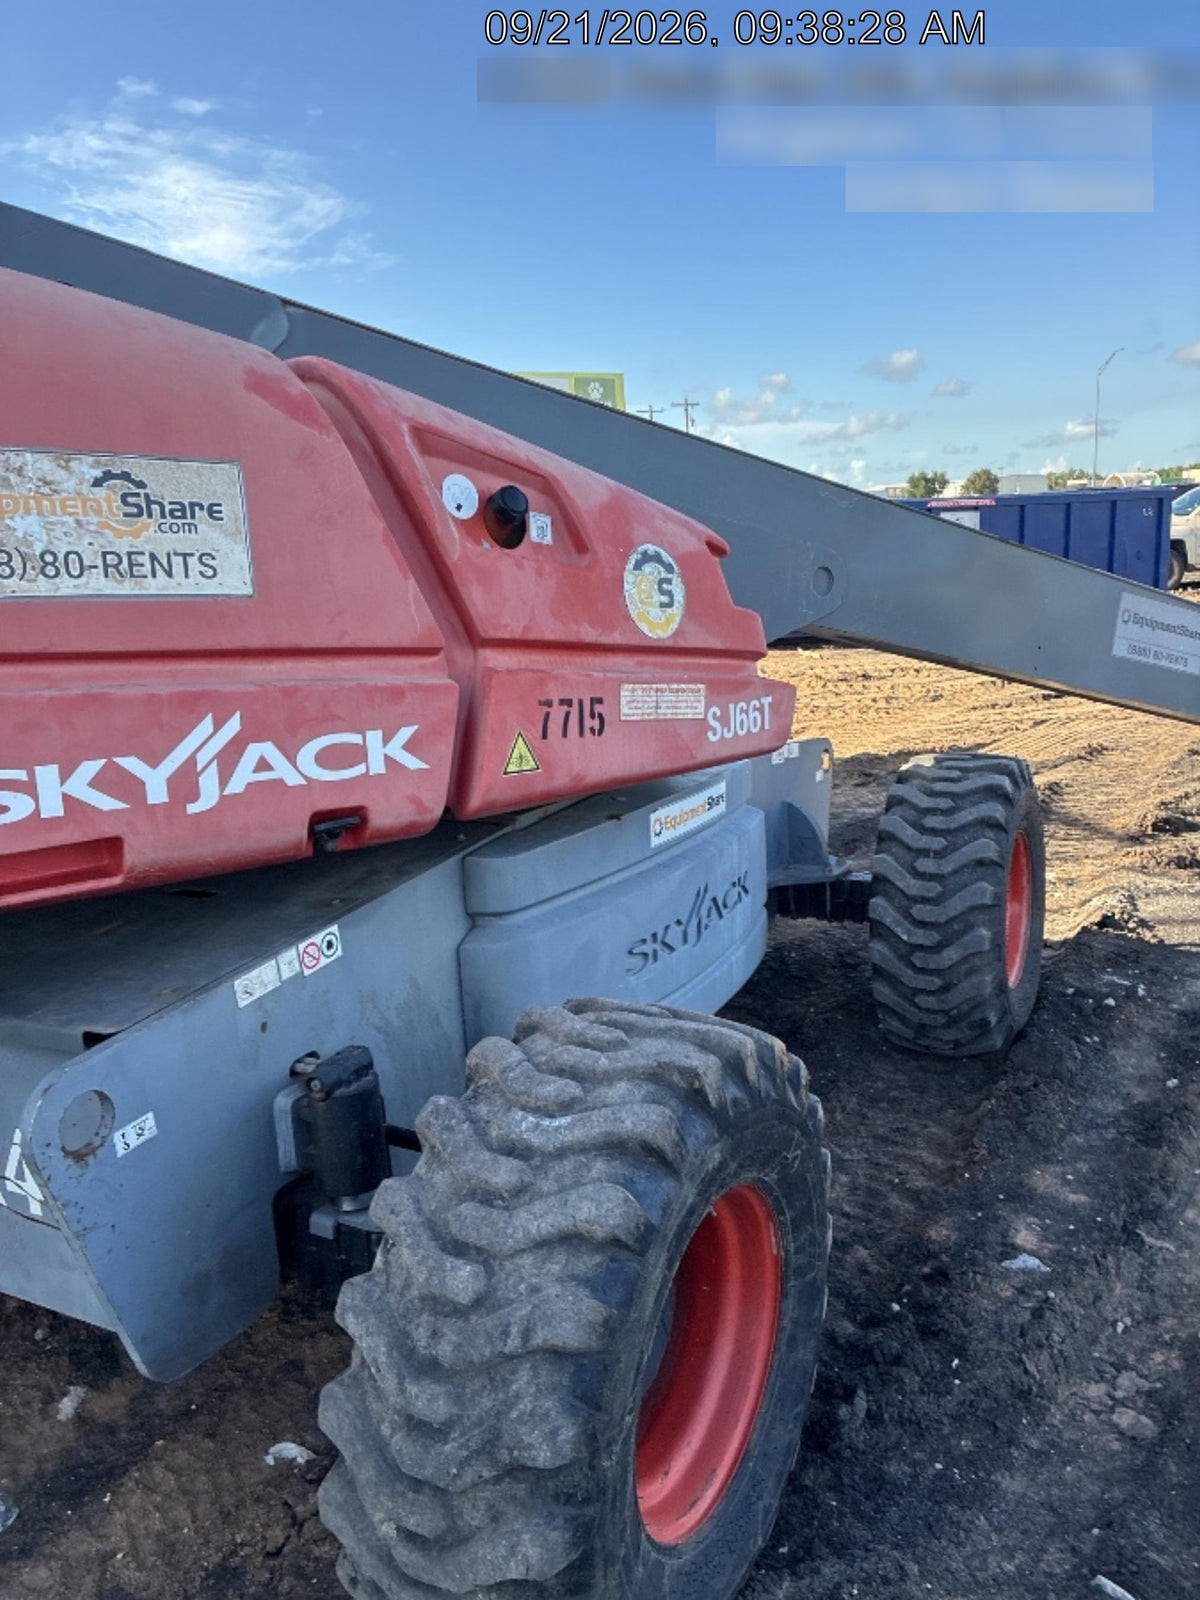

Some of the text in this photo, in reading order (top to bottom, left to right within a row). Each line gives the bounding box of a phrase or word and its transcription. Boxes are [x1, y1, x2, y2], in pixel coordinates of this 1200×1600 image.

[154, 521, 198, 534] .com
[40, 550, 217, 580] 80-RENTS
[538, 696, 605, 740] 7715
[707, 696, 773, 742] SJ66T
[0, 710, 431, 825] SKYJACK
[626, 871, 749, 975] SKYJACK
